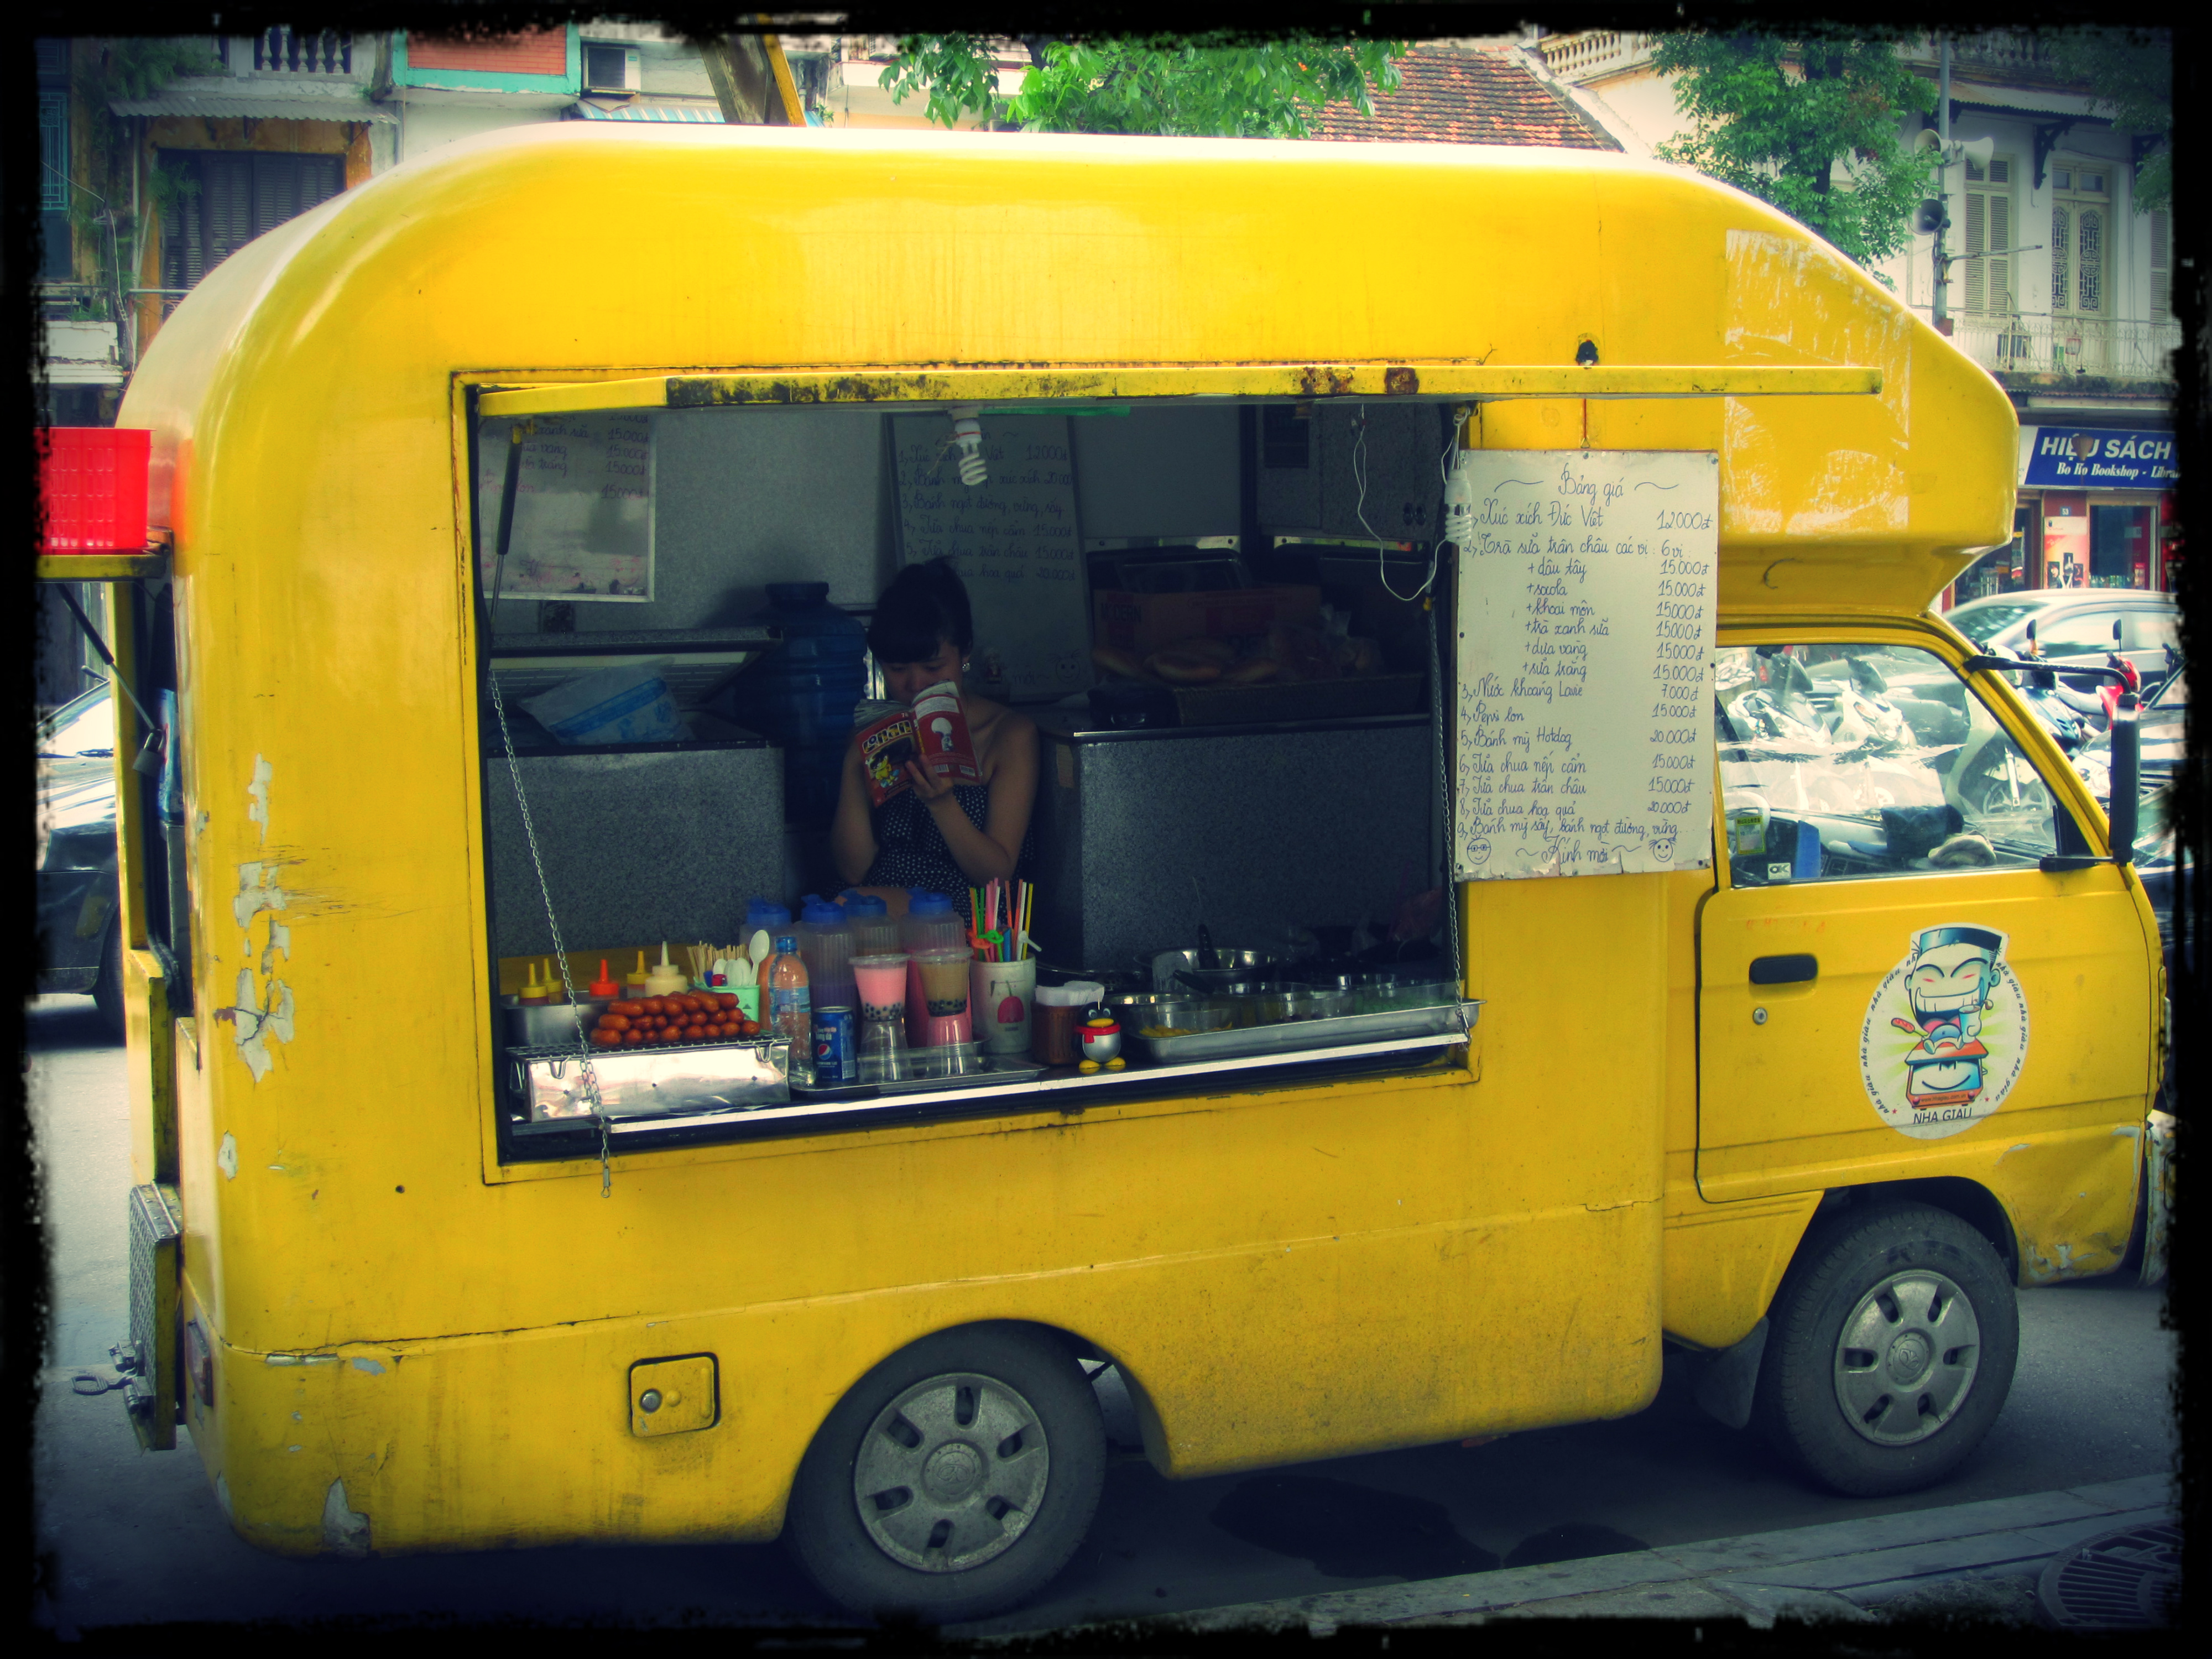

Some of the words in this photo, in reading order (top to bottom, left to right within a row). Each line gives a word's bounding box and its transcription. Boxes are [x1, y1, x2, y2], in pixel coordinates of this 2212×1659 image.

[2104, 435, 2172, 460] SÁCH
[2057, 462, 2071, 475] Bo
[2091, 463, 2139, 480] Bookshop
[1603, 477, 1624, 507] giá
[1480, 498, 1508, 525] Xúc
[1515, 502, 1542, 525] xích
[1547, 535, 1574, 554] trân
[1580, 534, 1609, 554] châu
[1616, 535, 1634, 555] các
[1565, 557, 1587, 583] tây
[1101, 602, 1141, 625] MDERN
[1570, 599, 1595, 616] môn
[1554, 617, 1586, 635] xanh
[1559, 681, 1583, 697] Lavie
[1504, 706, 1525, 722] lon
[1474, 724, 1507, 747] Bánh
[1537, 726, 1573, 752] Hotdog
[1500, 751, 1528, 773] chua
[1499, 774, 1526, 794] chua
[1531, 777, 1554, 794] trân
[1561, 776, 1587, 794] châu
[1498, 799, 1524, 816] chua
[1470, 816, 1505, 835] Bánh
[1770, 864, 1790, 874] OK
[1913, 1110, 1938, 1124] NHA
[1942, 1107, 1972, 1121] GIAU
